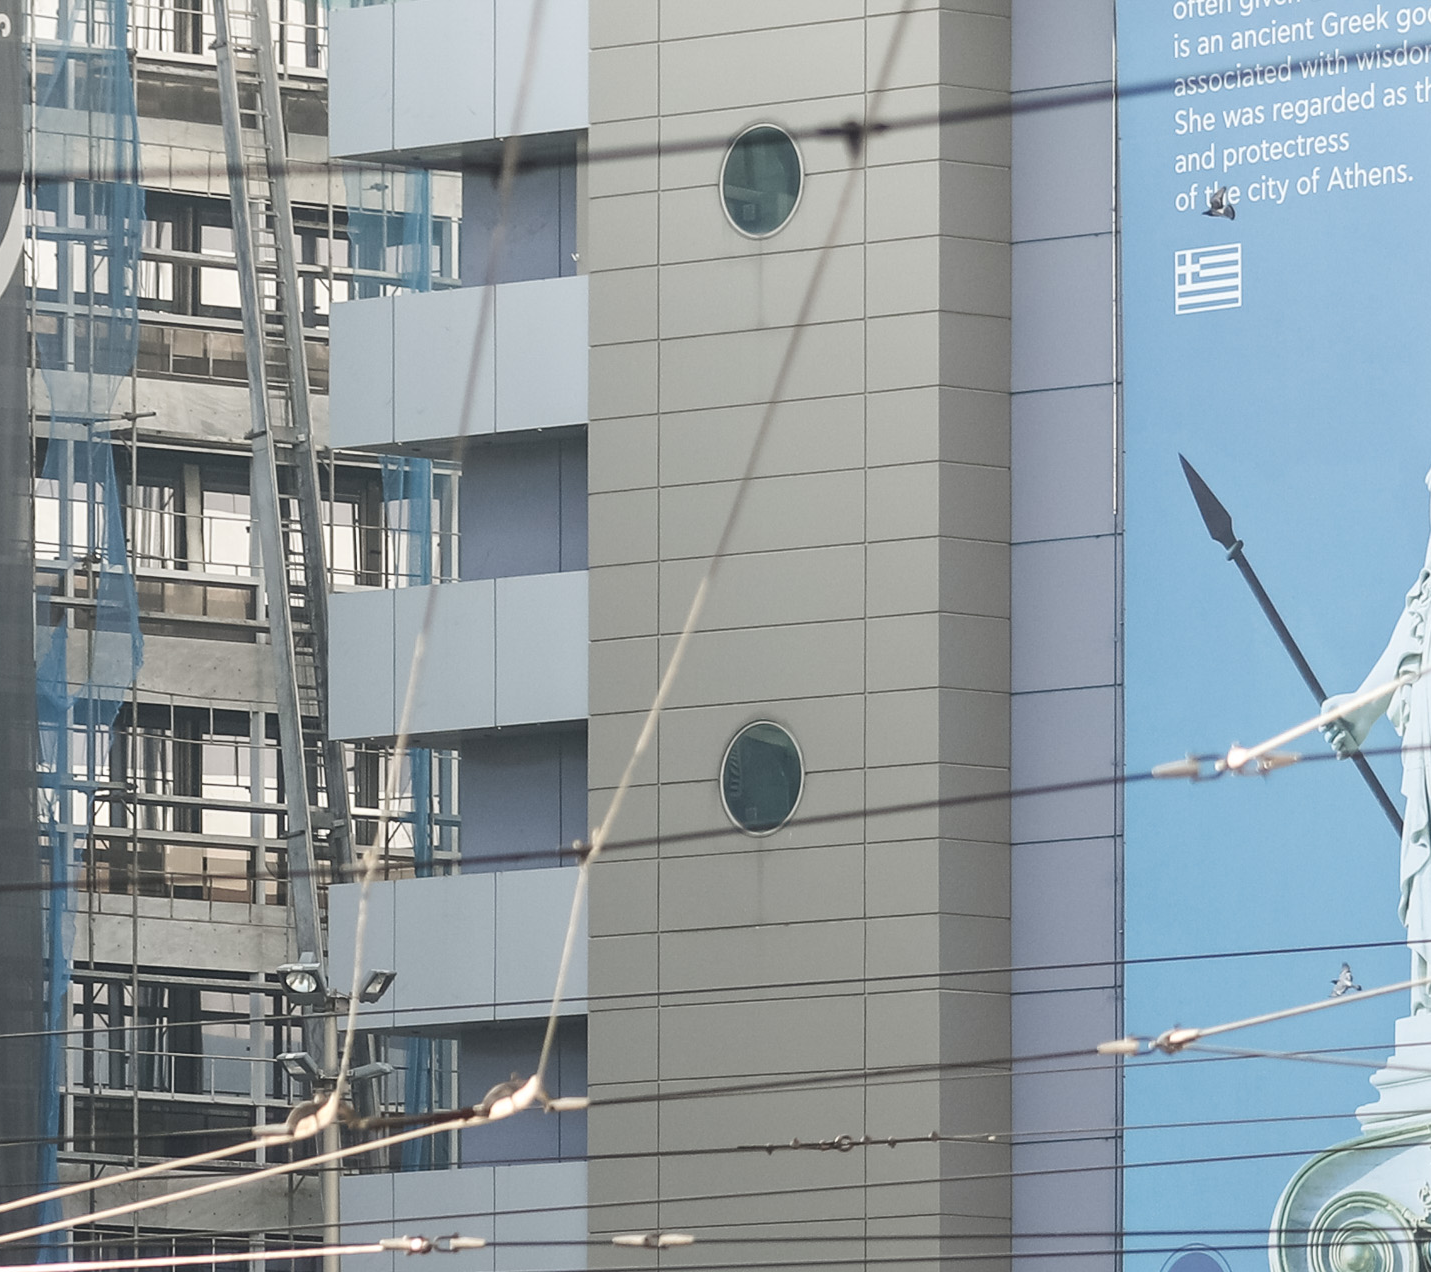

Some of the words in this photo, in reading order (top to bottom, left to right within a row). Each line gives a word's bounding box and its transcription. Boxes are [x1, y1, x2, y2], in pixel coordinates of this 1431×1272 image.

[1173, 34, 1191, 59] is
[1197, 33, 1224, 56] an
[1231, 18, 1315, 51] ancient
[1321, 4, 1390, 38] Greek
[1174, 55, 1292, 97] associated
[1299, 48, 1348, 79] with
[1174, 107, 1216, 136] She
[1222, 104, 1265, 129] was
[1272, 82, 1375, 125] regarded
[1382, 85, 1408, 108] as
[1174, 143, 1215, 174] and
[1222, 131, 1350, 173] protectress
[1174, 183, 1199, 212] of
[1247, 174, 1289, 204] city
[1296, 166, 1321, 196] of
[1327, 162, 1414, 192] Athens.
